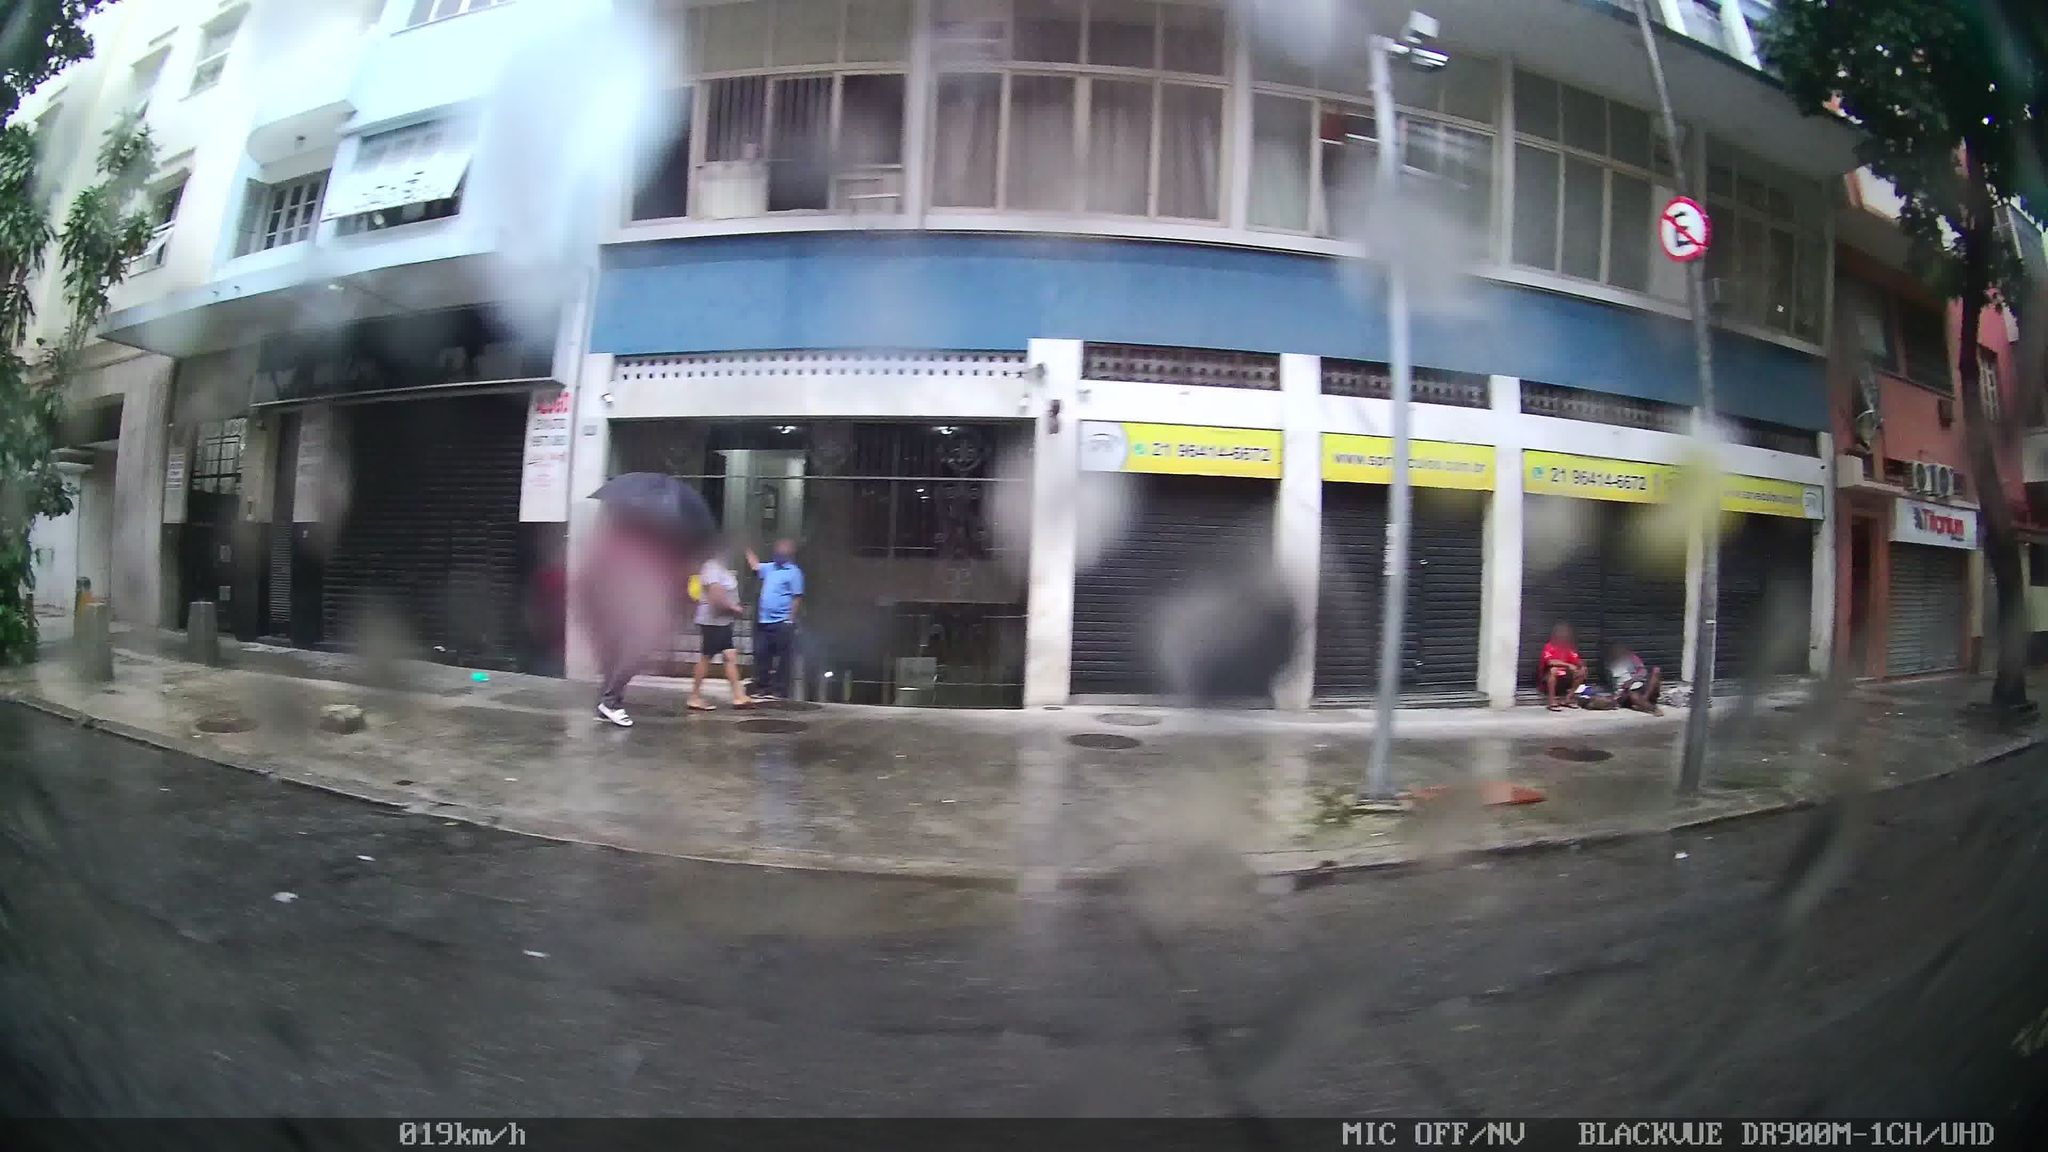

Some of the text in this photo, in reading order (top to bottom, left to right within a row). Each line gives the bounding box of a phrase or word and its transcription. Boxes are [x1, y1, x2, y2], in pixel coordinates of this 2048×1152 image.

[1152, 442, 1170, 457] 21
[1551, 467, 1648, 491] 21 96414-6672
